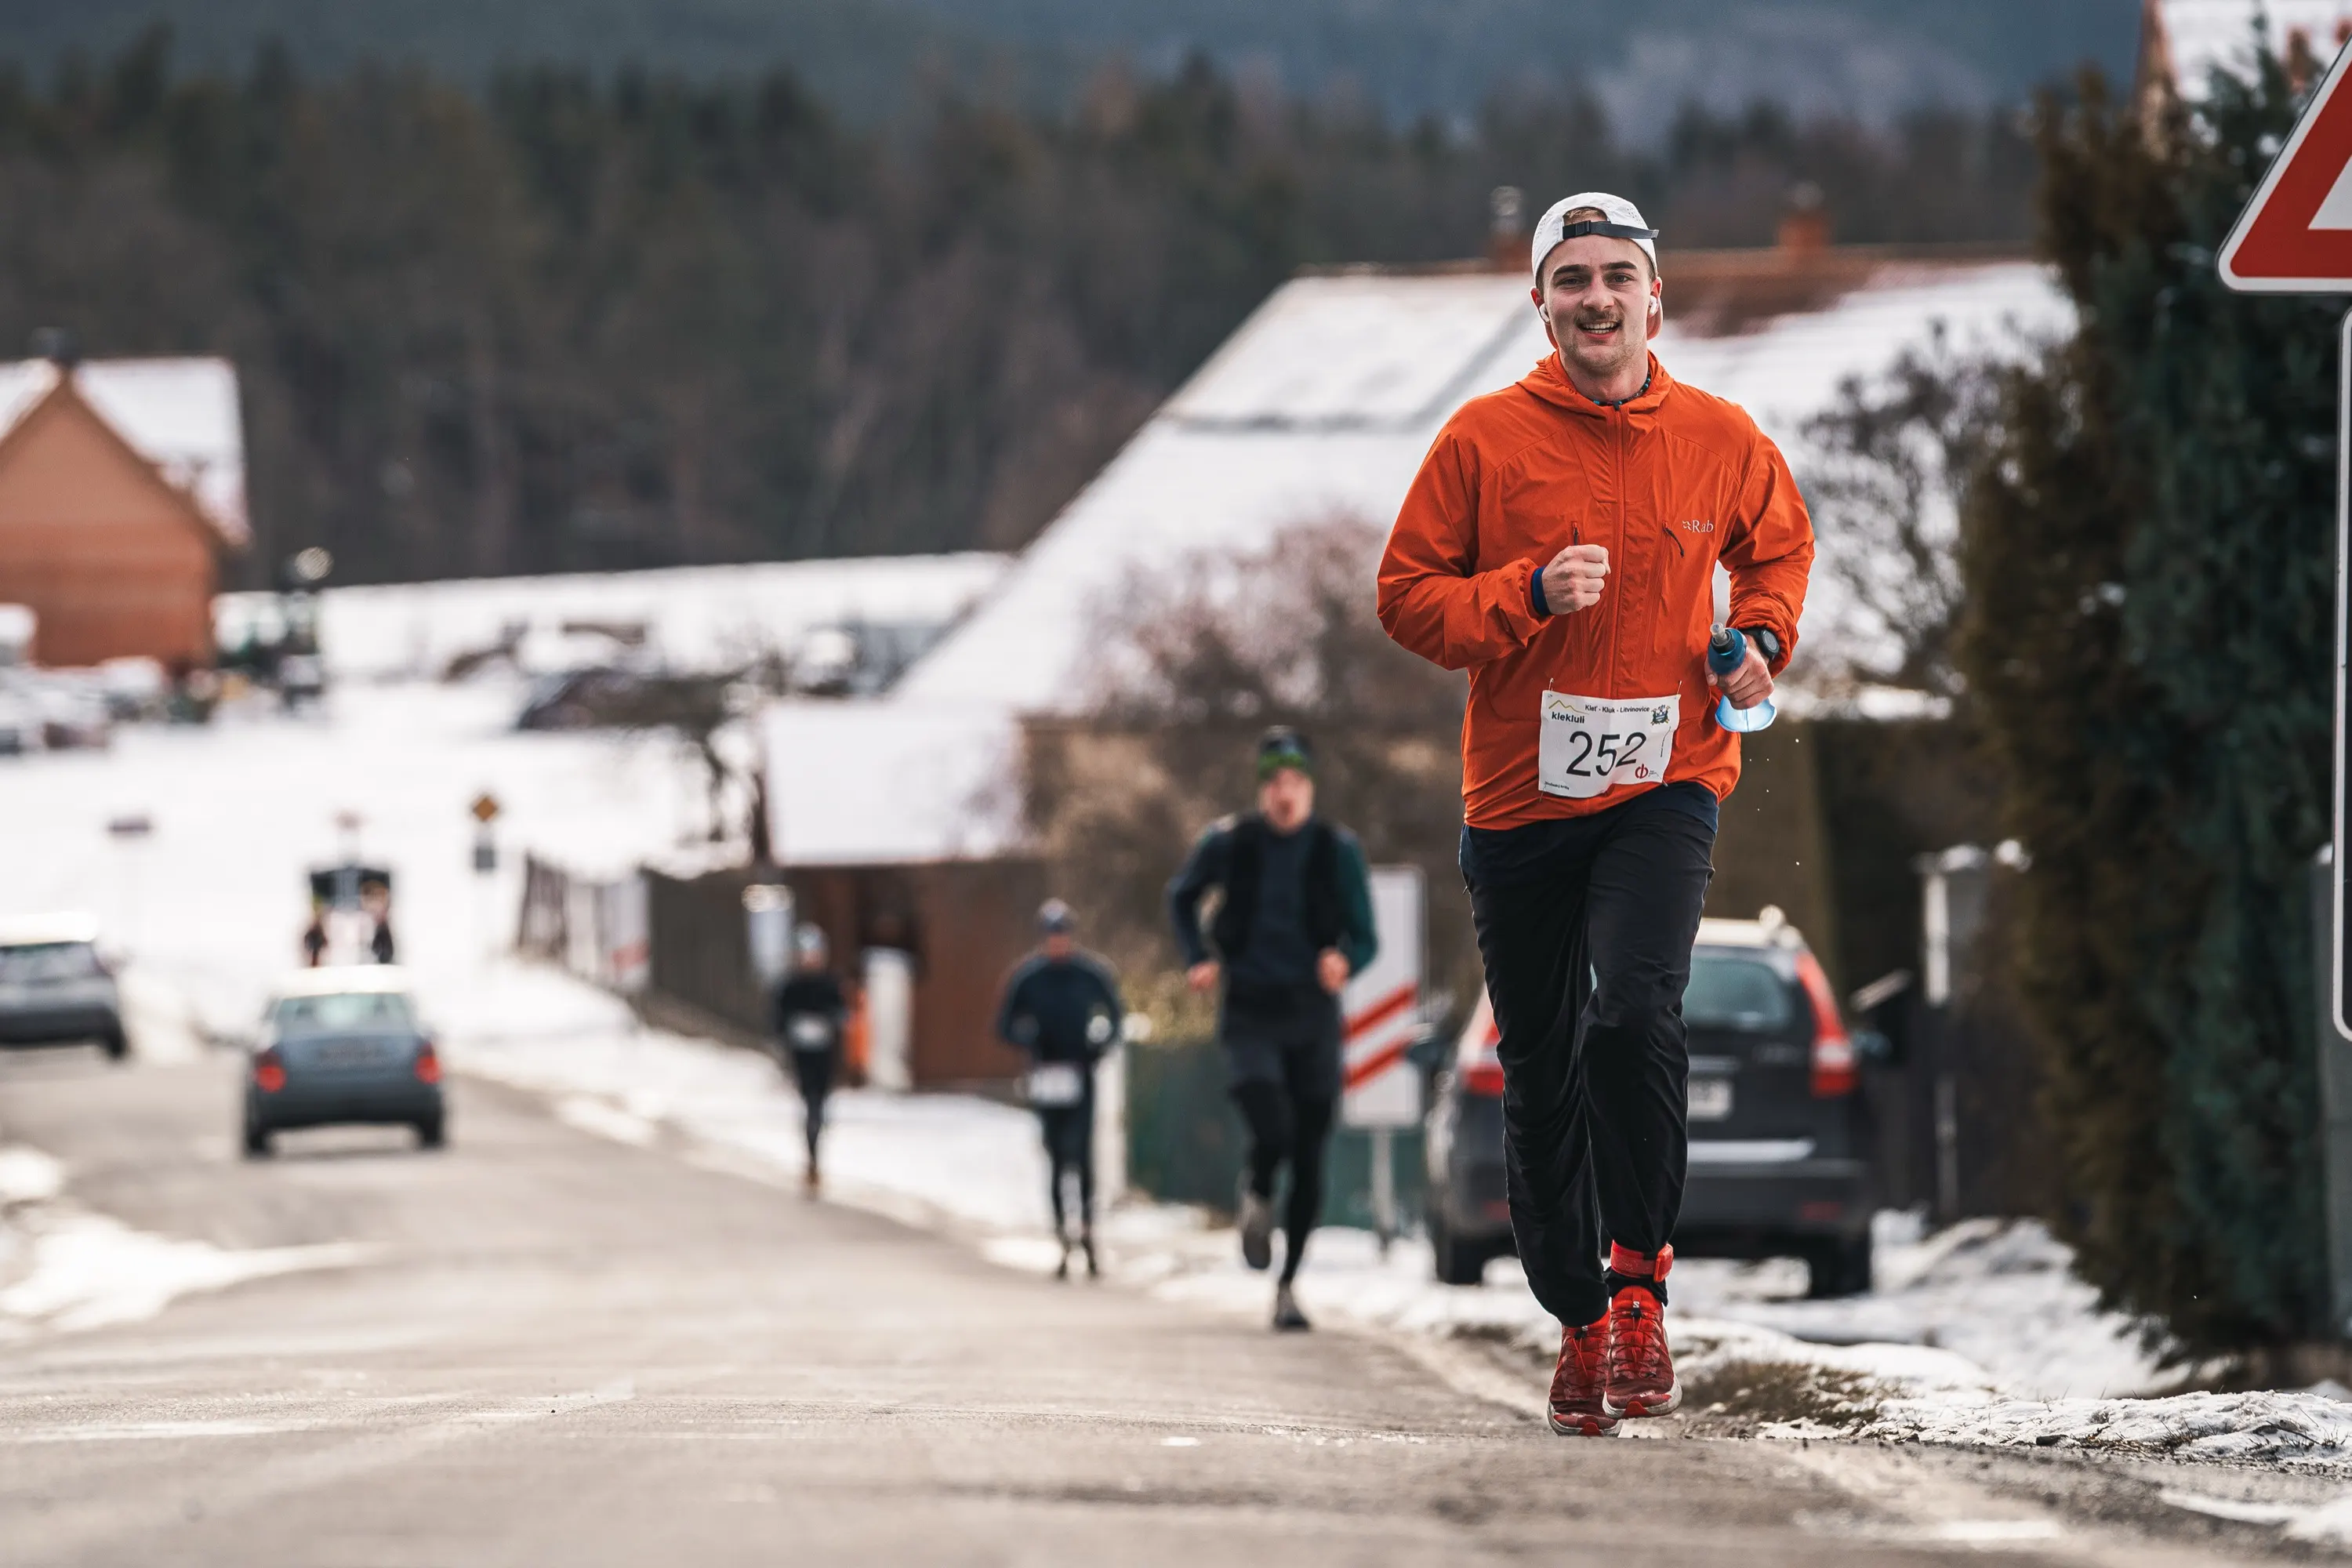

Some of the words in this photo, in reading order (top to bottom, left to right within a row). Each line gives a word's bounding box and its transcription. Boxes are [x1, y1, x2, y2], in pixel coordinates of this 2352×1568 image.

[1692, 519, 1713, 533] Rab
[1552, 711, 1584, 724] klekluli
[1566, 731, 1646, 777] 252
